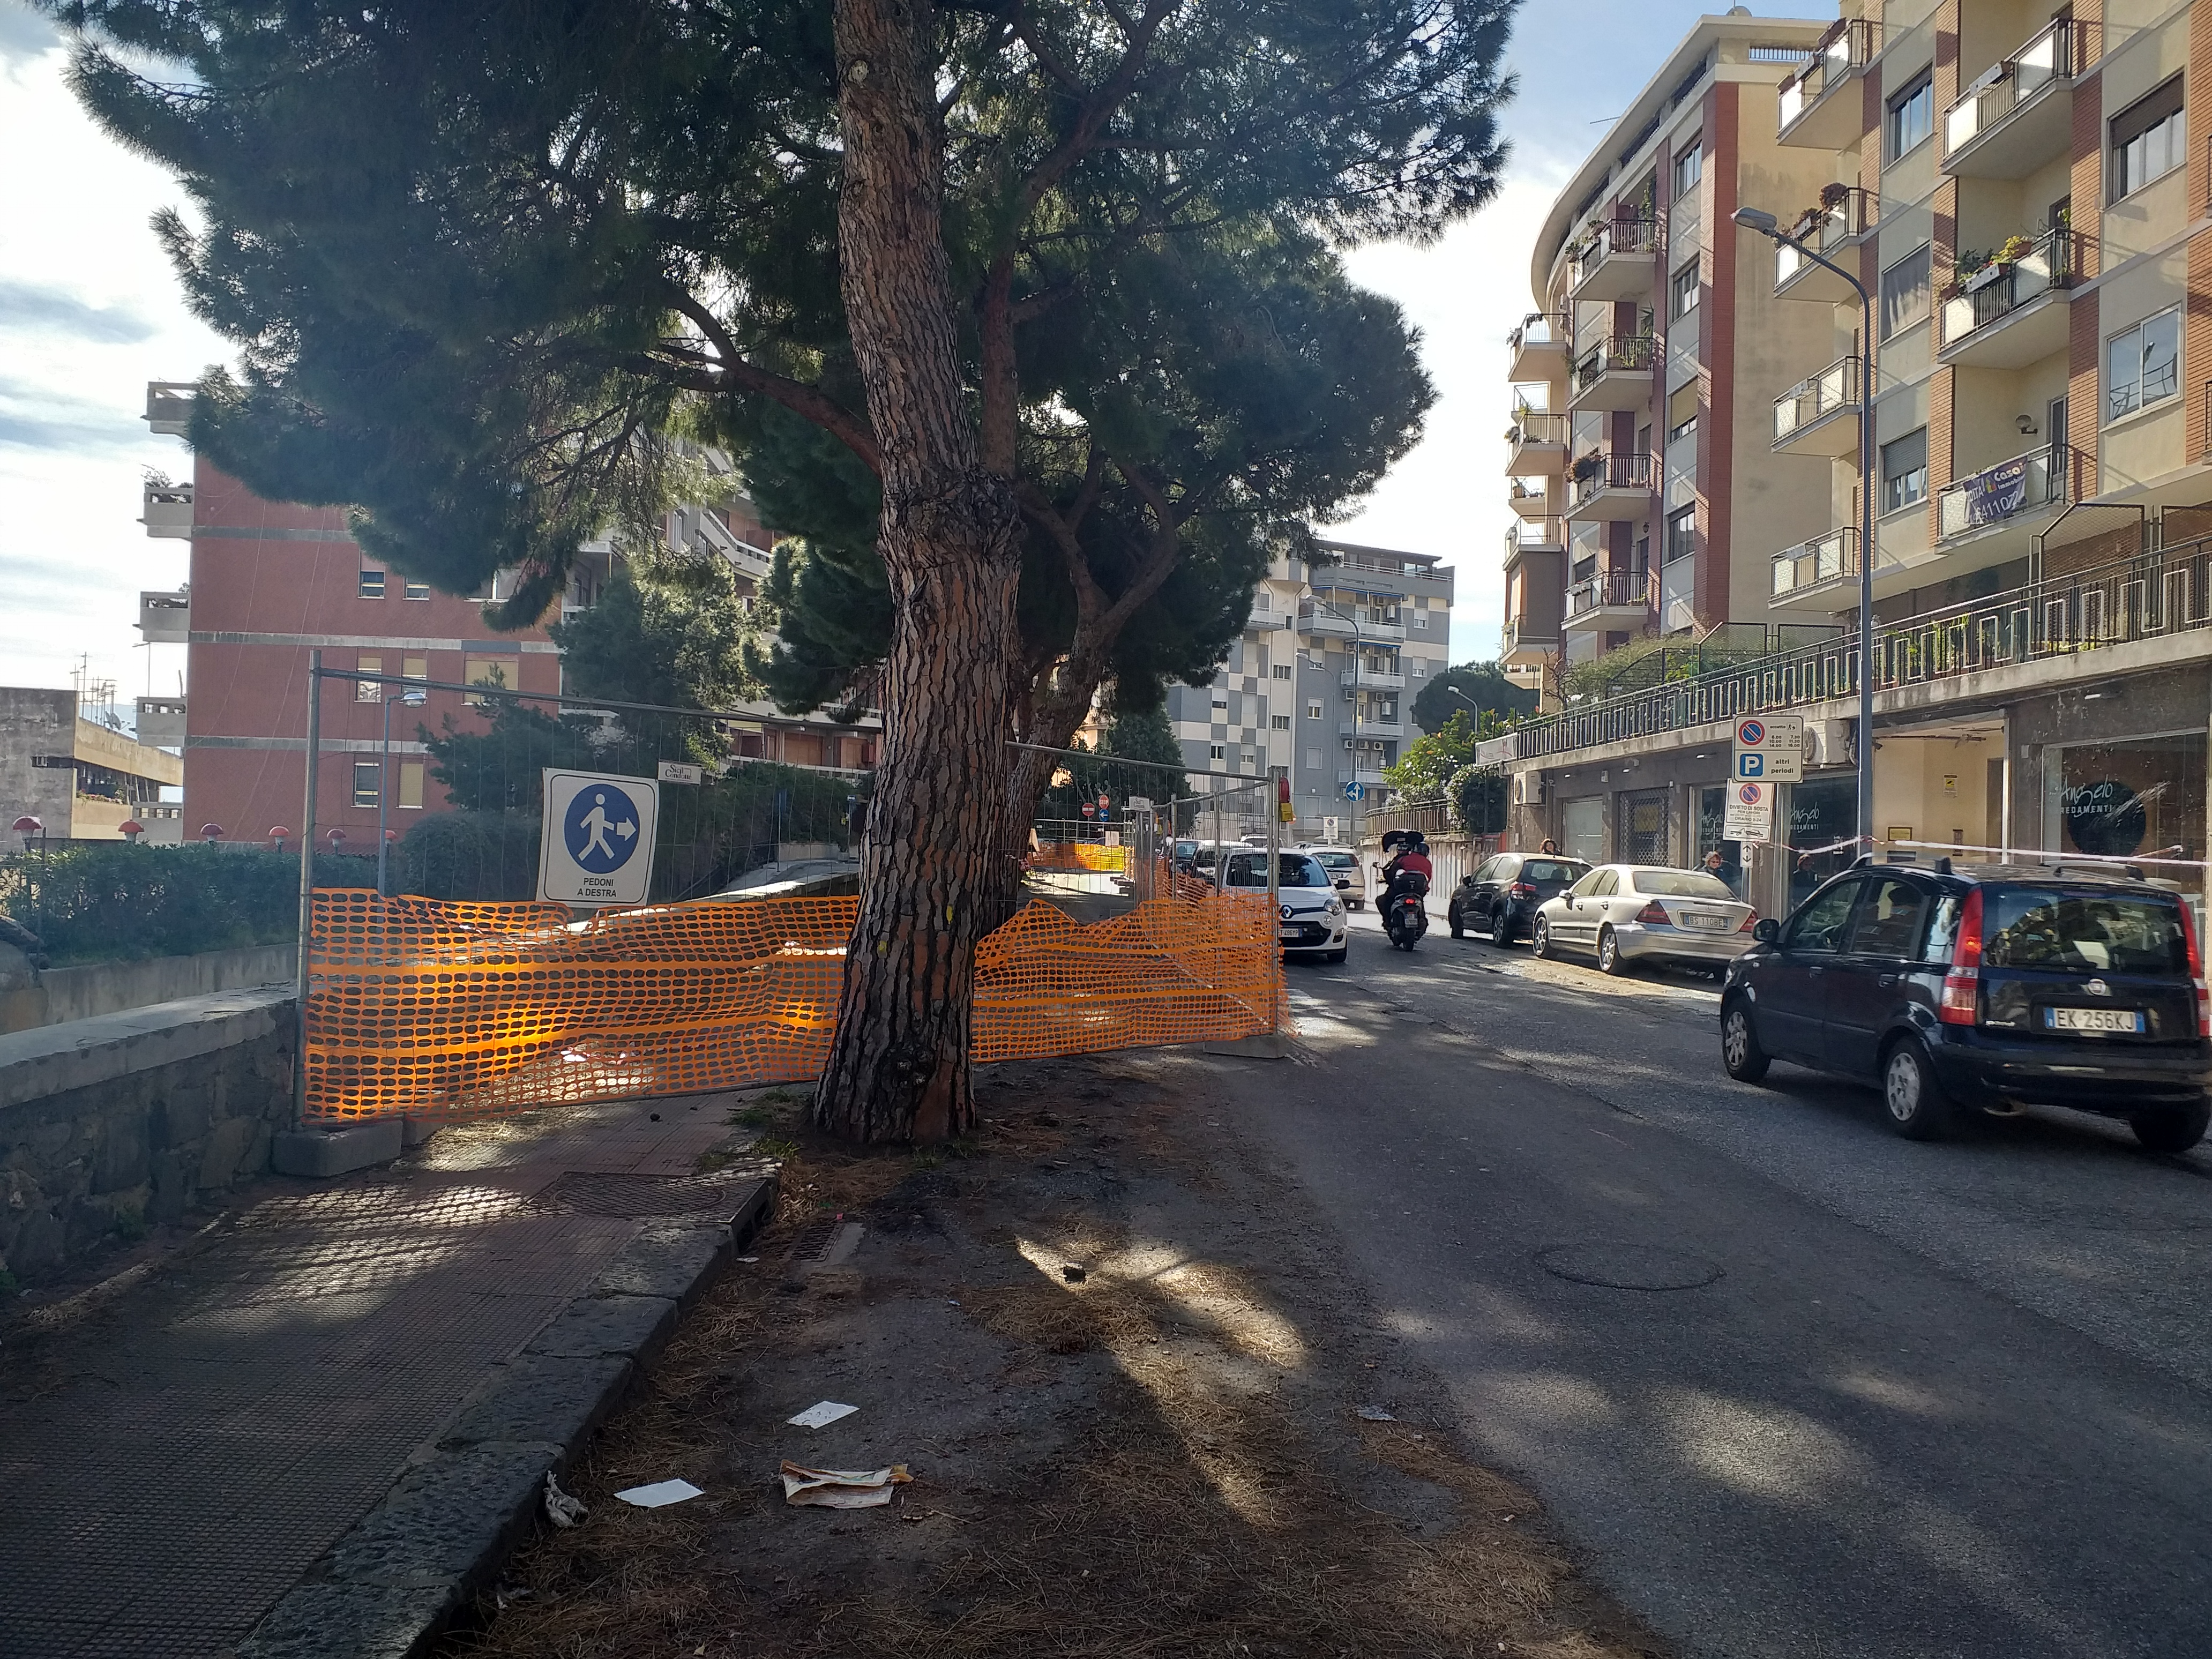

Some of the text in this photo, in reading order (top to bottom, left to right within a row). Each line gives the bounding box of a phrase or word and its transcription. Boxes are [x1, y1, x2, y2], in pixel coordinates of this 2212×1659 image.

[1745, 756, 1759, 774] P
[584, 877, 614, 886] PEDONI
[577, 888, 616, 897] A DESTRA
[1702, 918, 1723, 926] 110BE
[2057, 1010, 2134, 1030] EK 256KJ
